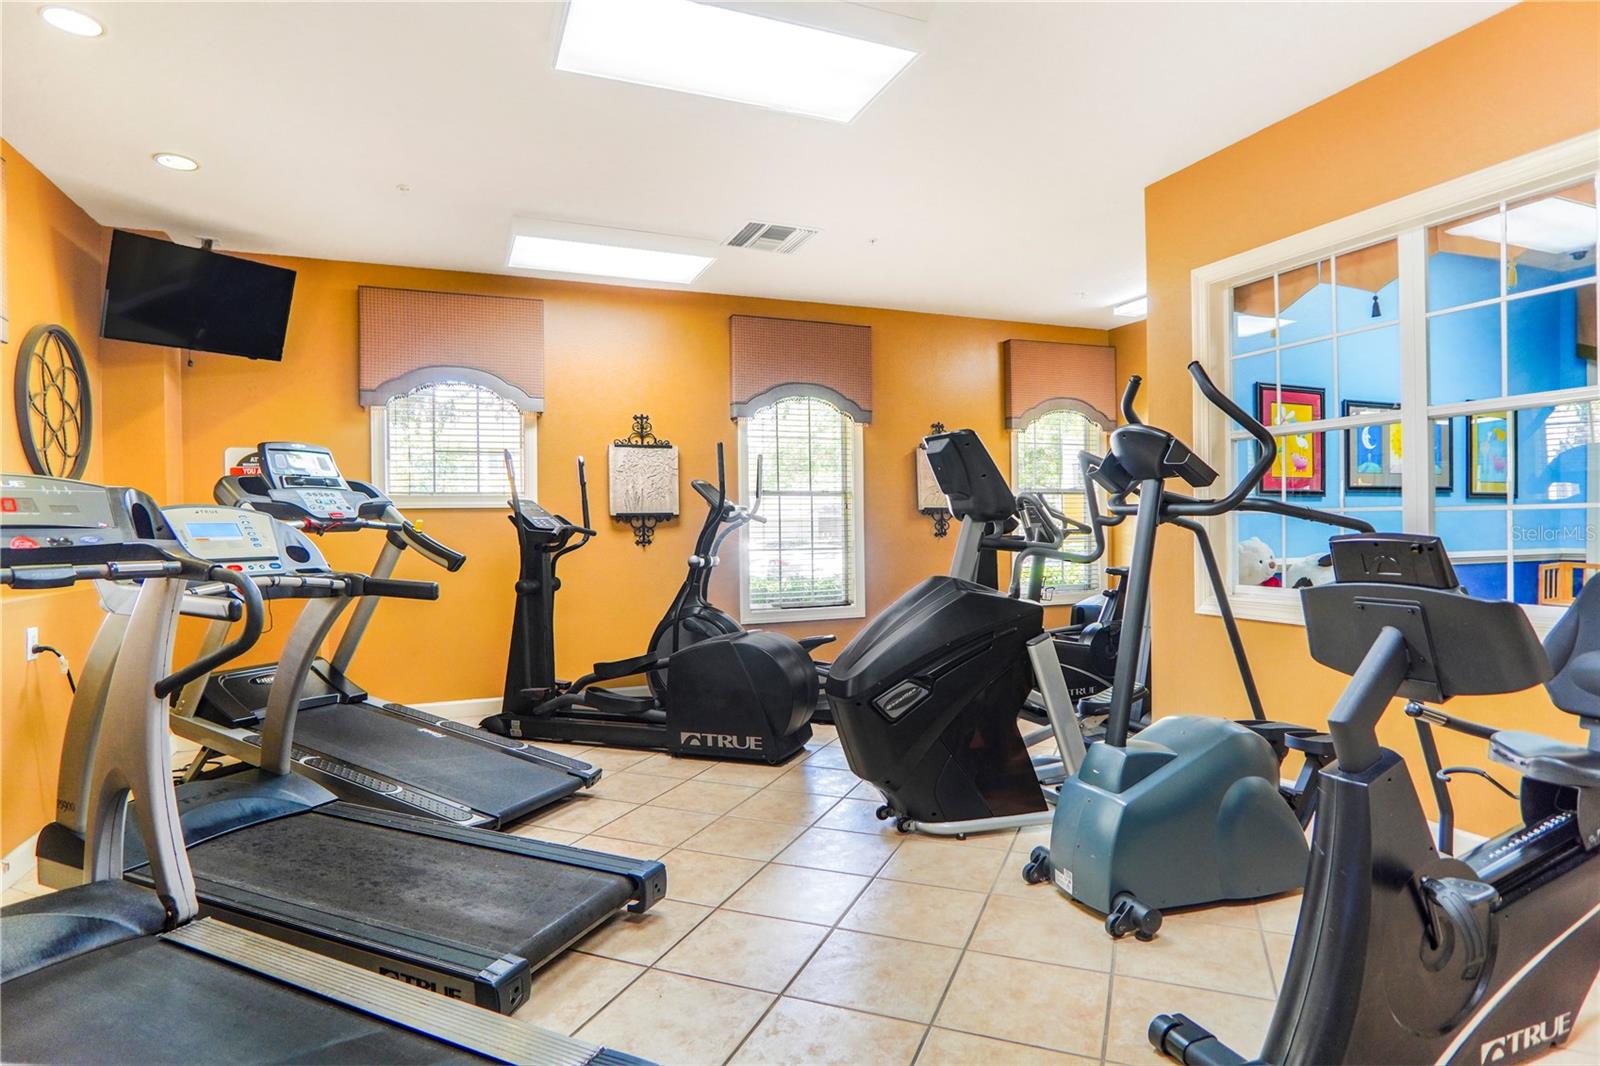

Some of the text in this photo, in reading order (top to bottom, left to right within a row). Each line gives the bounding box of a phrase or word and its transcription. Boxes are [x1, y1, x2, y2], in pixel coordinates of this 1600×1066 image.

[1069, 686, 1097, 696] TRUE
[701, 733, 763, 751] TRUE
[1506, 1011, 1572, 1055] TRUE
